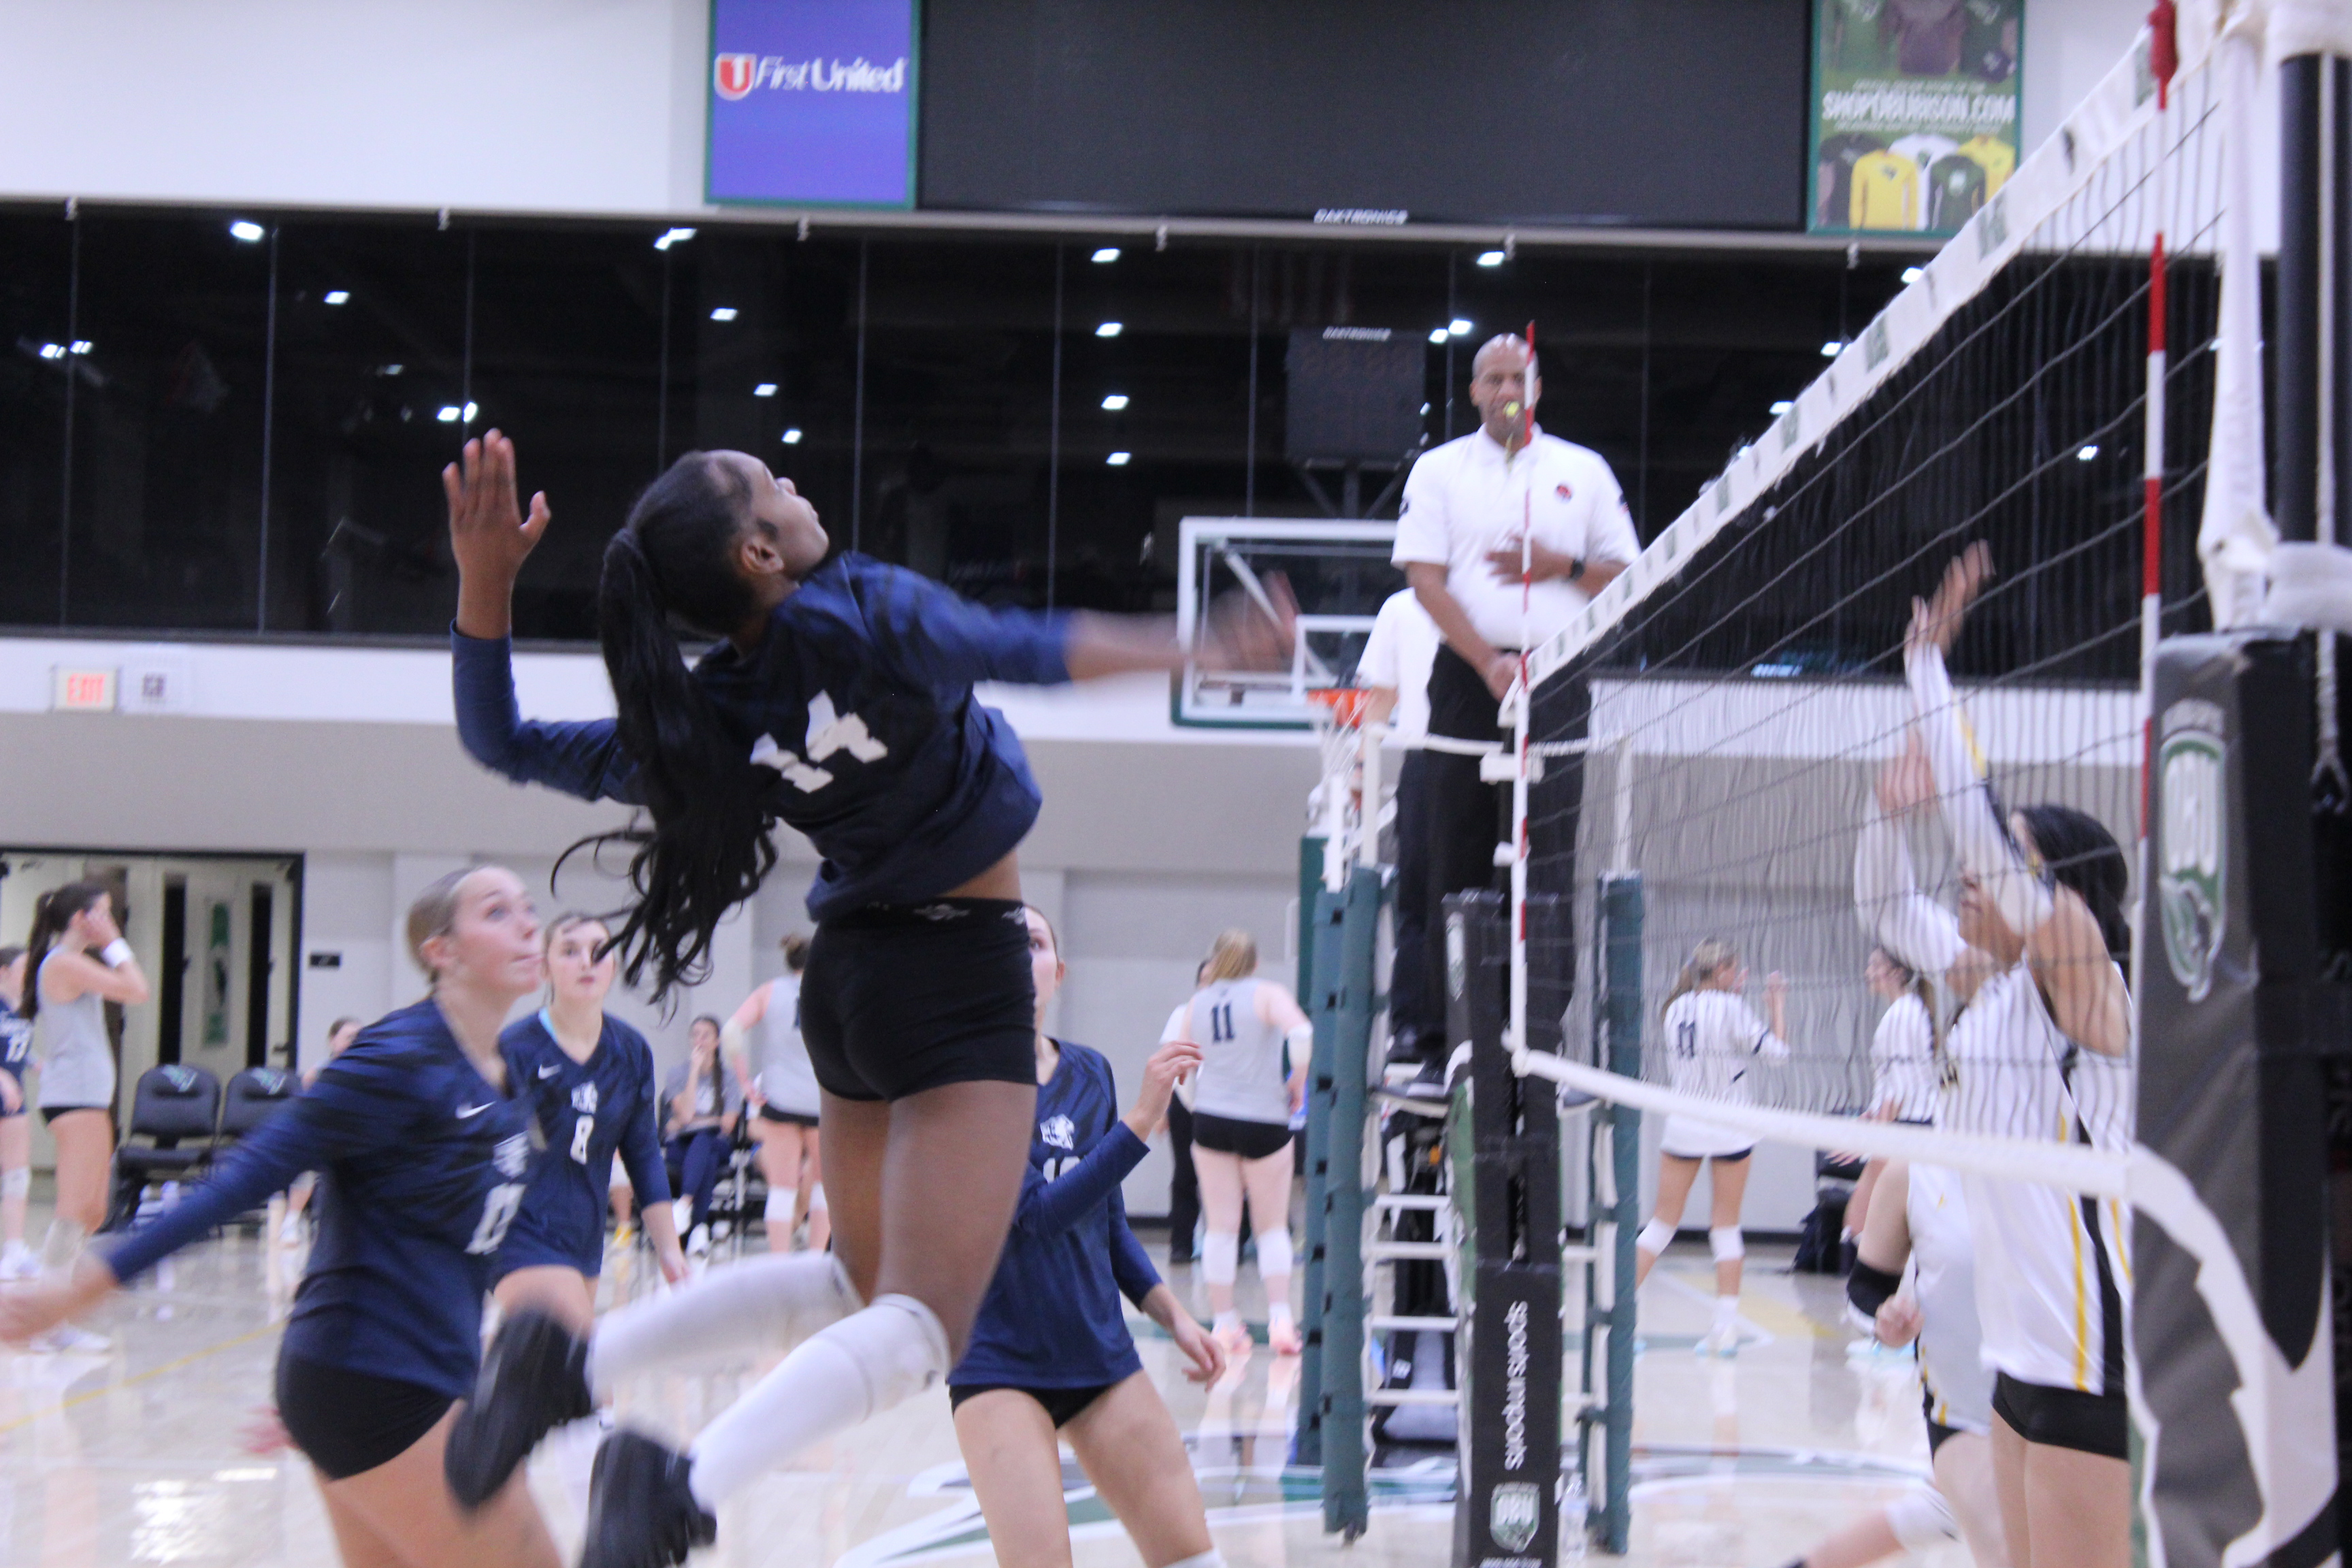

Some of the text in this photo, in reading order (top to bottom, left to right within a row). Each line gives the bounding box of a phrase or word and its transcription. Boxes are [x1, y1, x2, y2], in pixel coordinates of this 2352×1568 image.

[754, 56, 910, 93] First United
[1211, 1000, 1235, 1043] 11
[570, 1114, 594, 1164] 8
